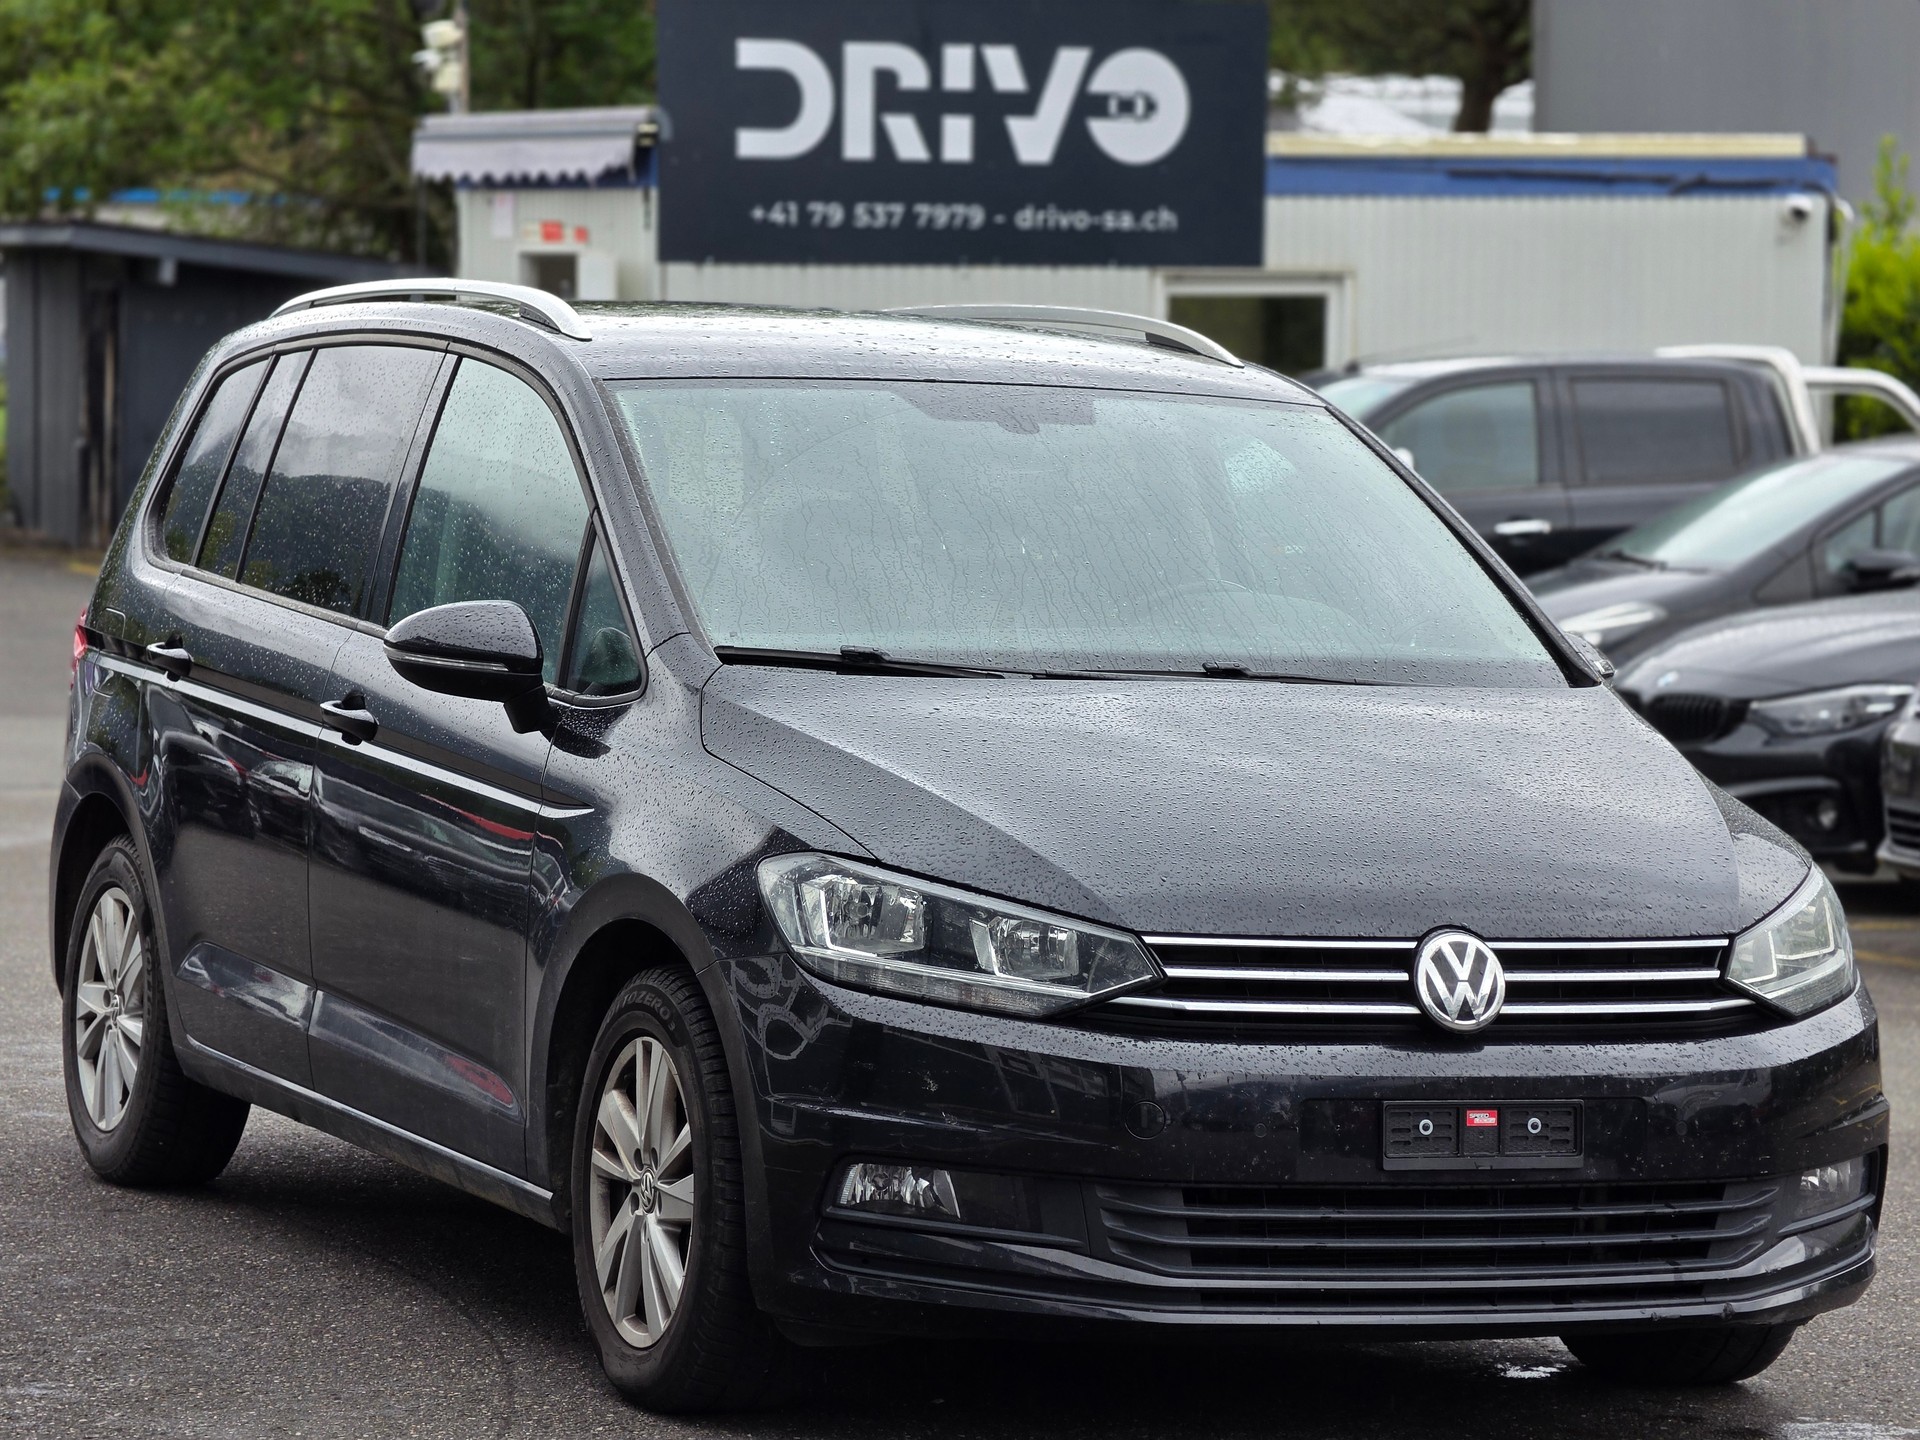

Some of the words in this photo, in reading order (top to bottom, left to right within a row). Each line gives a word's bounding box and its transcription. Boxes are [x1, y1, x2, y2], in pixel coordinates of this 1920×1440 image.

[735, 37, 1190, 165] DRIVO
[751, 202, 798, 225] +41
[806, 202, 845, 228] 79
[853, 202, 906, 228] 537
[913, 203, 986, 229] 7979
[1014, 206, 1178, 231] drivo-sa.ch
